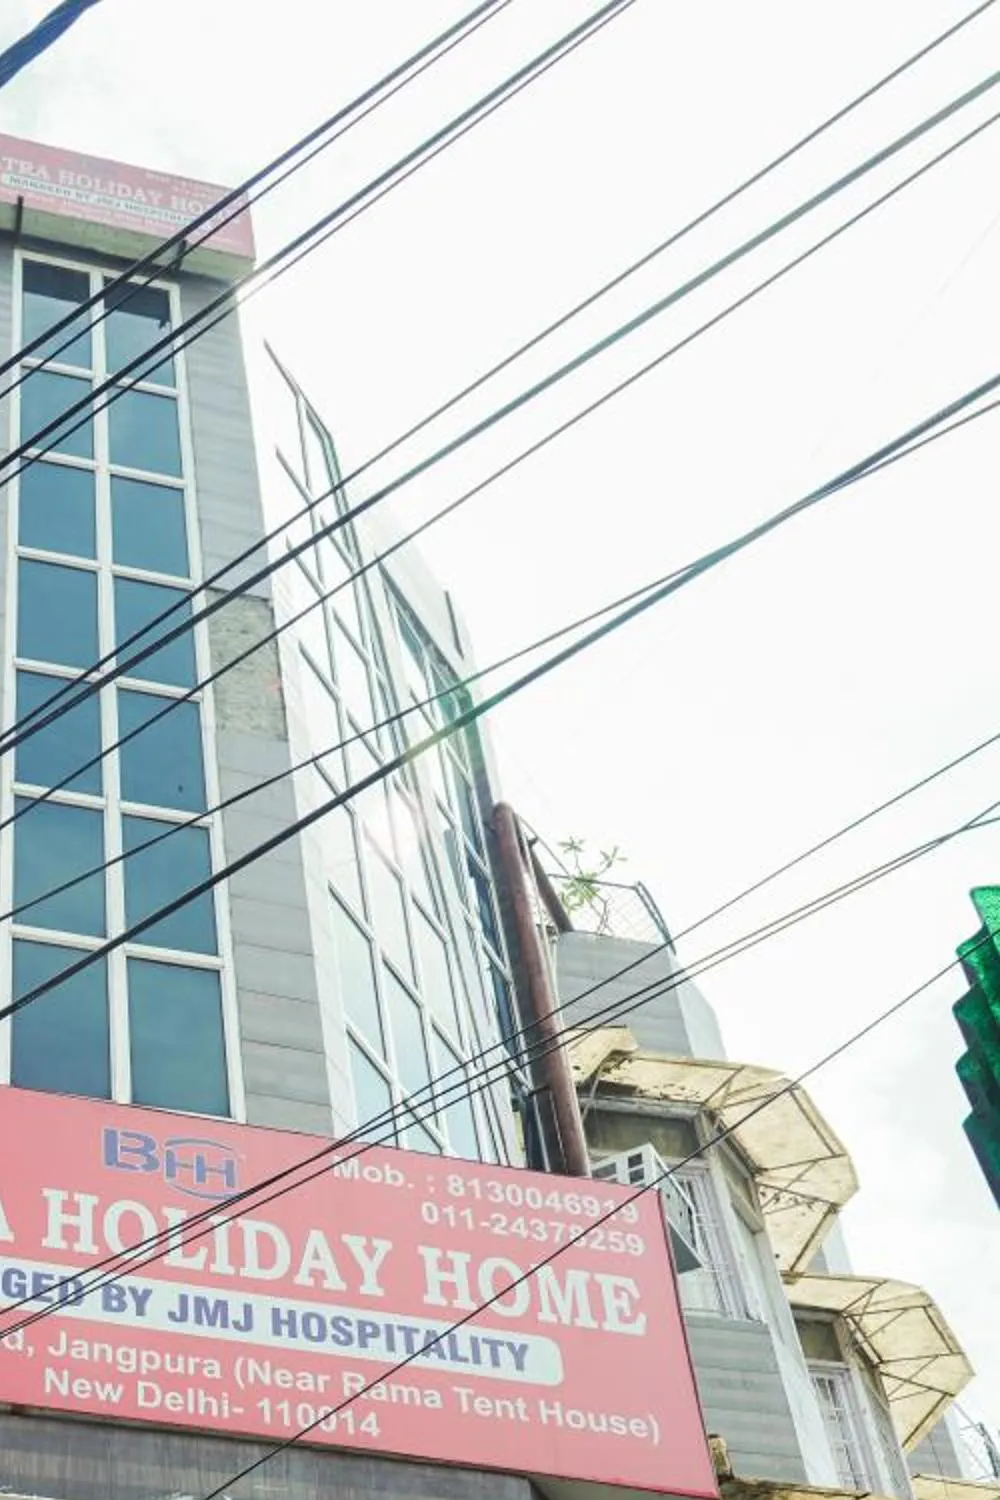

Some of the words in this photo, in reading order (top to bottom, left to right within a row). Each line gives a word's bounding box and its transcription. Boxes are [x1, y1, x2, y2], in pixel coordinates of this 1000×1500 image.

[445, 1173, 640, 1224] 8130046919
[41, 1187, 393, 1298] HOLIDAY
[417, 1244, 647, 1336] HOME
[101, 1284, 153, 1317] BY
[166, 1294, 254, 1333] JMJ
[271, 1307, 530, 1372] HOSPITALITY
[43, 1367, 125, 1405] New
[136, 1381, 245, 1419] Delhi-
[255, 1398, 382, 1439] 110014
[47, 1331, 223, 1380] Jangpura
[233, 1356, 332, 1395] (Near
[342, 1372, 444, 1409] Rama
[453, 1386, 530, 1423] Tent
[538, 1400, 661, 1446] House)
